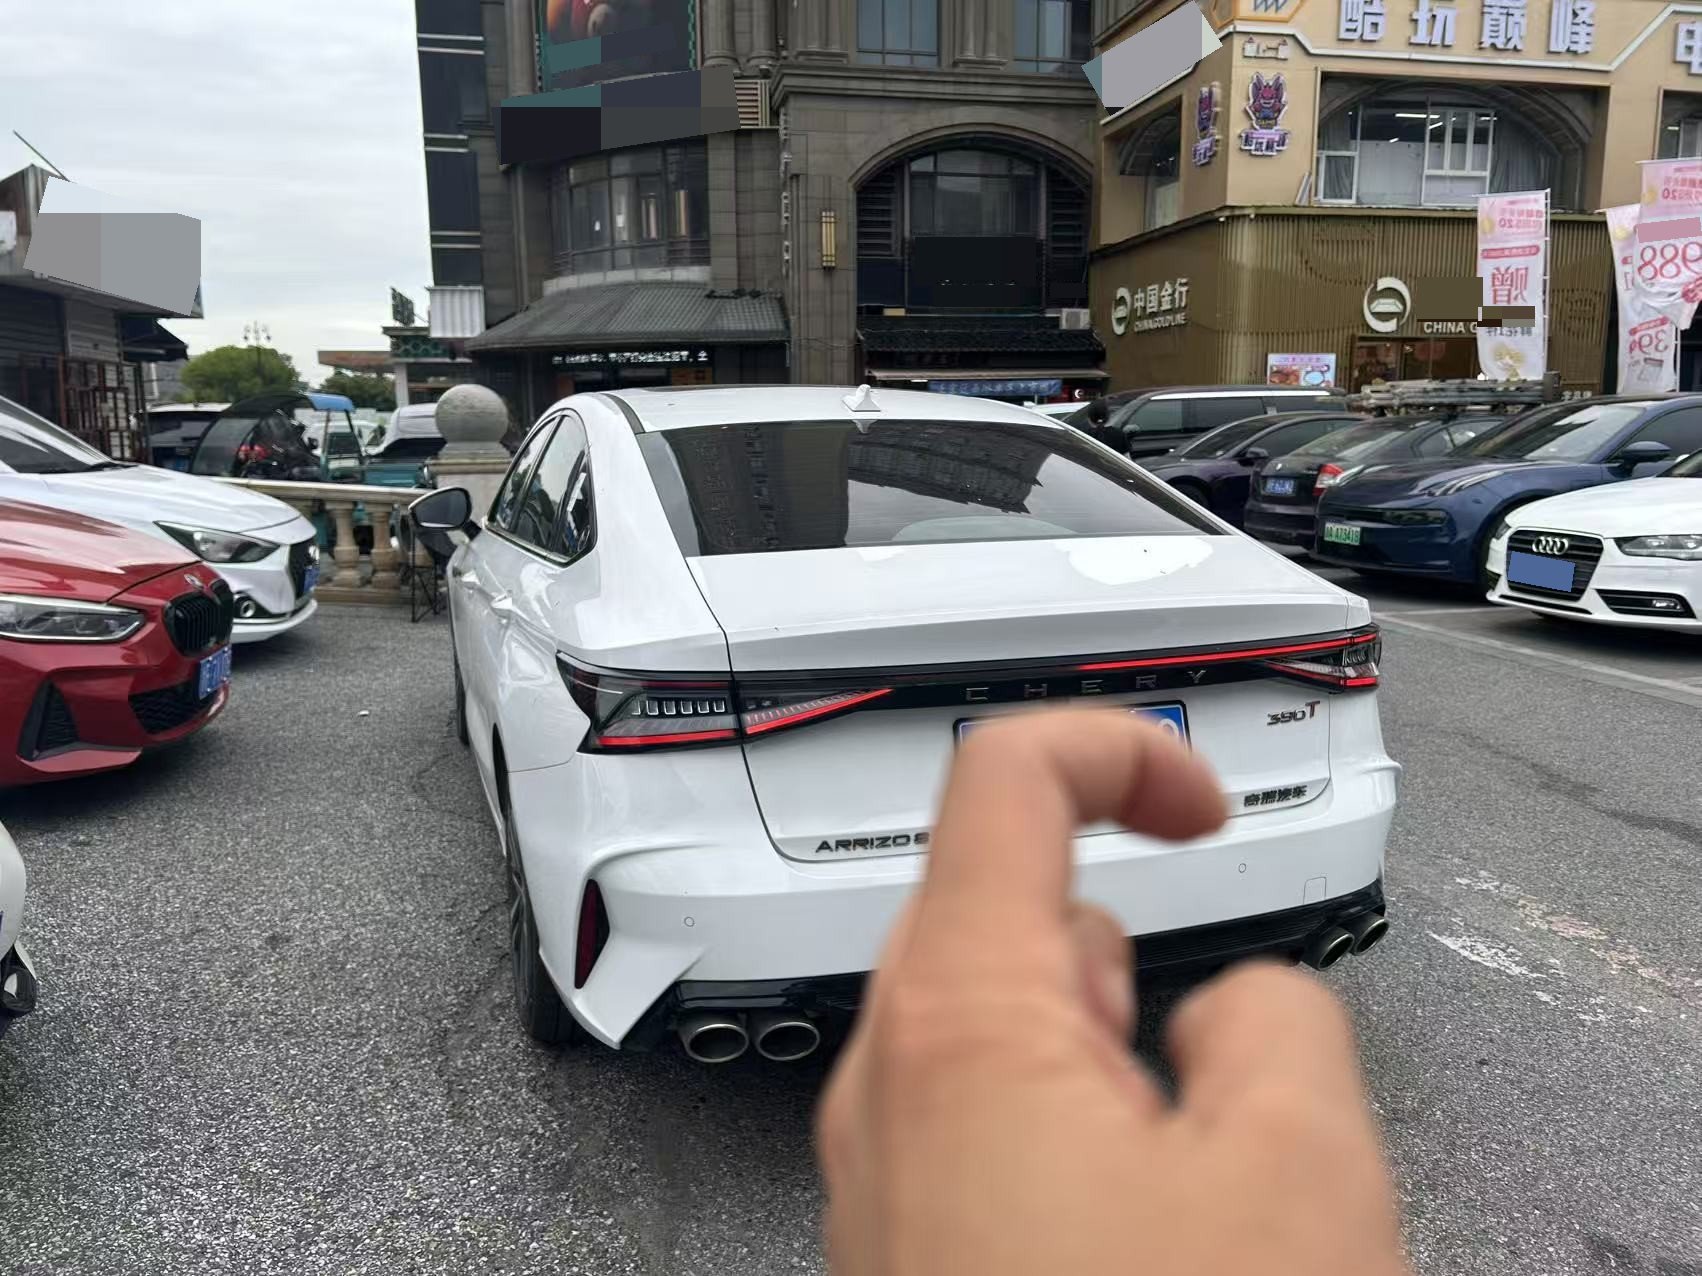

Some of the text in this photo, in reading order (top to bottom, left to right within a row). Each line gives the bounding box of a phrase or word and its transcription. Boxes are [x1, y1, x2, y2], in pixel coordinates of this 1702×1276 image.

[1133, 277, 1189, 317] 中国金行
[1424, 322, 1466, 333] CHINA
[965, 670, 1207, 701] CHERY
[815, 834, 911, 853] ARRIZO
